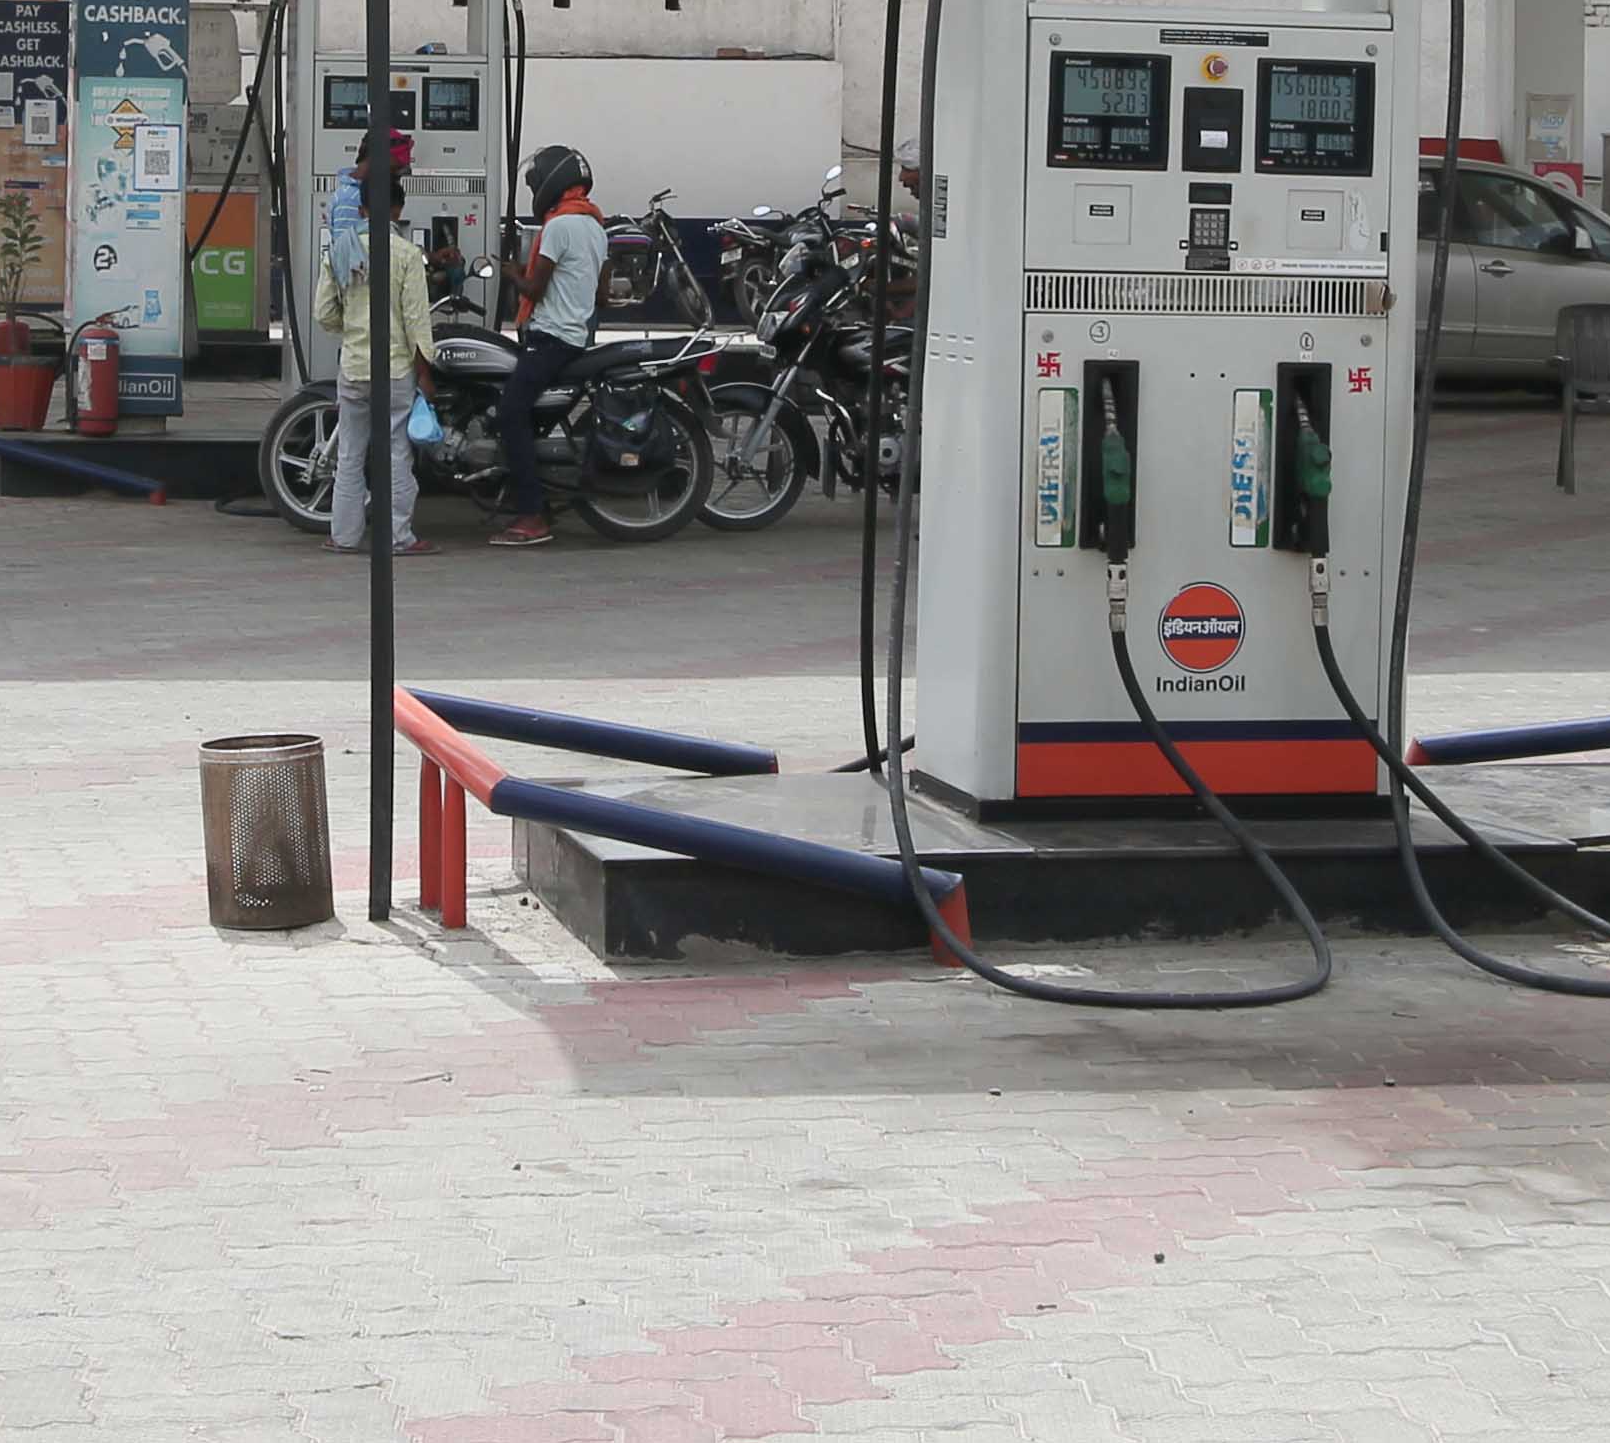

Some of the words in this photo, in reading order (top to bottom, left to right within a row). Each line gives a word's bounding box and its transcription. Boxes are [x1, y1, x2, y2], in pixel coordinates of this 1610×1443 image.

[16, 5, 40, 17] PAY
[84, 5, 186, 25] CASHBACK.
[16, 38, 40, 50] GET
[1163, 617, 1240, 638] इंडियनऑयल
[1156, 675, 1245, 692] IndianOil
